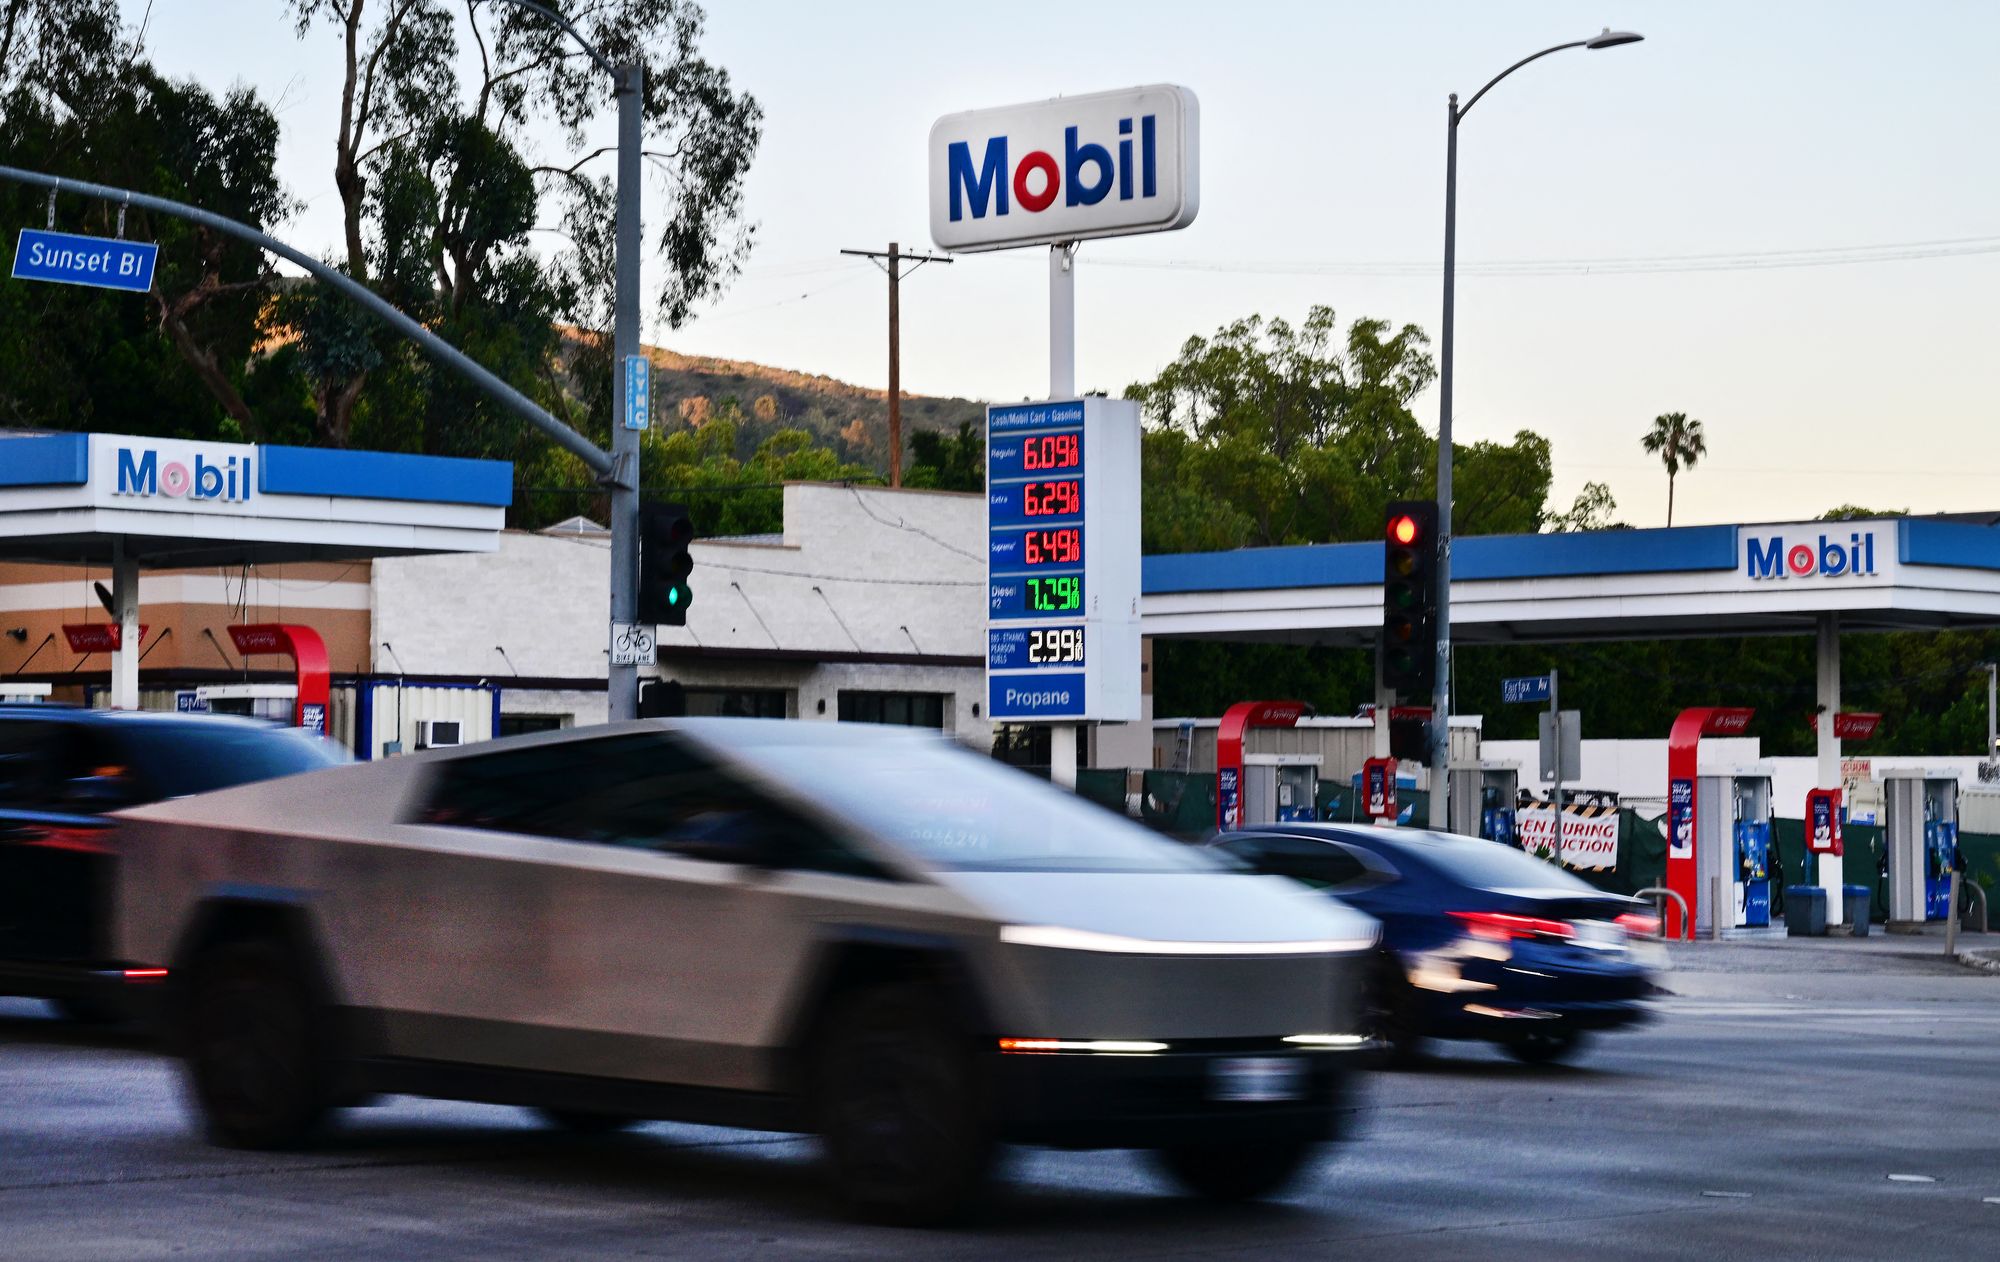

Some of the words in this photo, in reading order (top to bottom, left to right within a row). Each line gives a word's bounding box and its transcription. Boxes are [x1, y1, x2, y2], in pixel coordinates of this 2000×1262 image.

[948, 114, 1156, 222] Mobil
[29, 242, 111, 273] Sunset
[119, 252, 143, 277] Bl
[1030, 410, 1046, 424] Card
[1052, 408, 1082, 422] Gasoline
[991, 447, 1017, 459] Regular
[1023, 435, 1070, 470] 6.09
[118, 448, 251, 501] Mobil
[990, 495, 1008, 504] Extra
[1024, 481, 1071, 516] 6.29
[1025, 530, 1072, 565] 6.49
[1747, 532, 1873, 577] Mobil
[991, 584, 1017, 598] Diesel
[1026, 577, 1071, 611] 7.29
[991, 597, 1002, 609] #2
[1029, 629, 1075, 663] 2.99
[1006, 689, 1070, 709] Propane
[1505, 680, 1530, 693] Fairfax
[1270, 710, 1297, 720] Synergy
